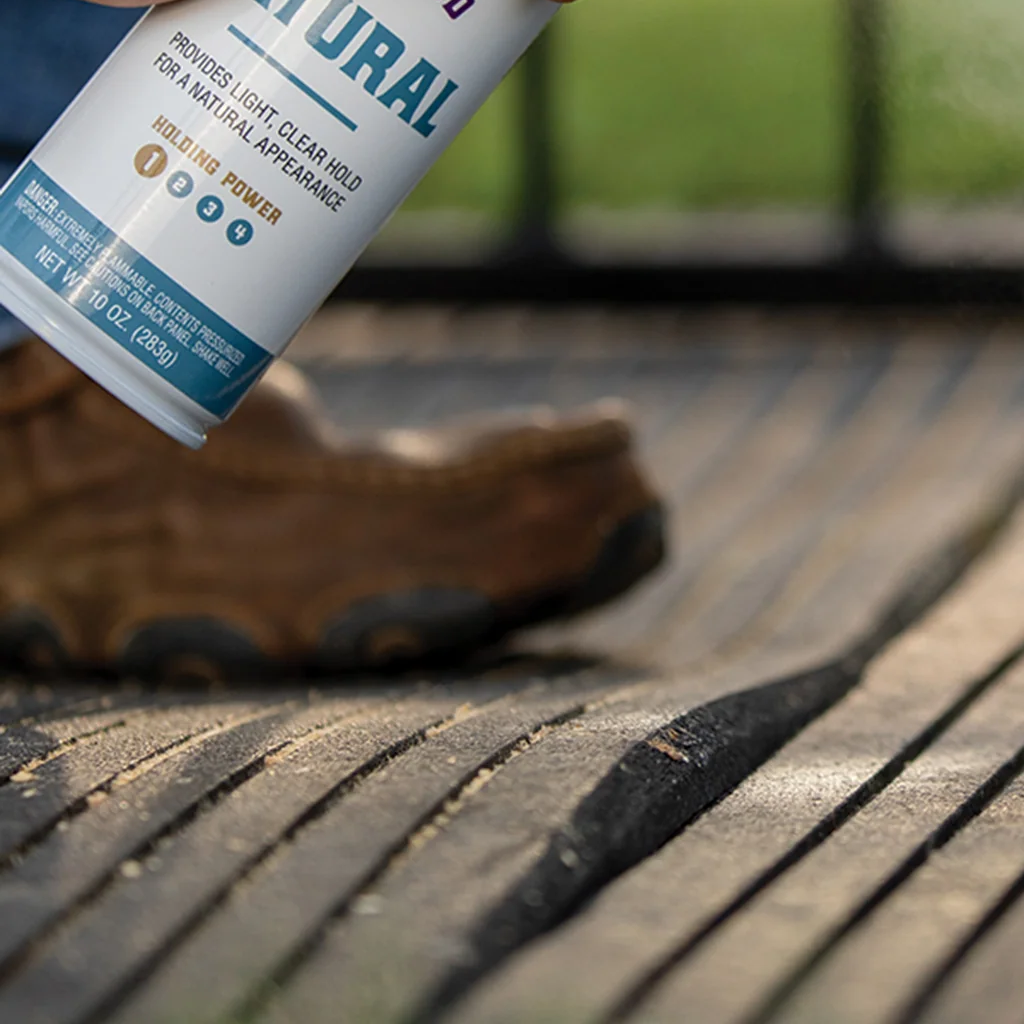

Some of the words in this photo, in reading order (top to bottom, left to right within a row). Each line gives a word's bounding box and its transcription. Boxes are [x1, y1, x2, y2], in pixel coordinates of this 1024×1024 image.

[151, 114, 221, 176] HOLDING
[220, 171, 283, 225] POWER
[153, 52, 181, 80] FOR
[176, 73, 192, 90] A
[188, 81, 255, 143] NATURAL
[254, 137, 346, 213] APPEARANCE
[169, 31, 233, 89] PROVIDES
[229, 81, 279, 130] LIGHT,
[278, 121, 328, 166] CLEAR
[324, 157, 363, 192] HOLD
[34, 244, 67, 274] NET
[62, 266, 92, 293] WT
[87, 289, 109, 311] 10
[106, 304, 132, 332] OZ.
[129, 325, 178, 369] (283g)
[54, 210, 104, 254] EXTREMELY
[153, 291, 201, 333] CONTENTS
[68, 243, 90, 262] SEE
[127, 291, 146, 308] ON
[140, 300, 168, 327] BACK
[191, 341, 221, 368] SHAKE
[214, 355, 236, 378] WELL
